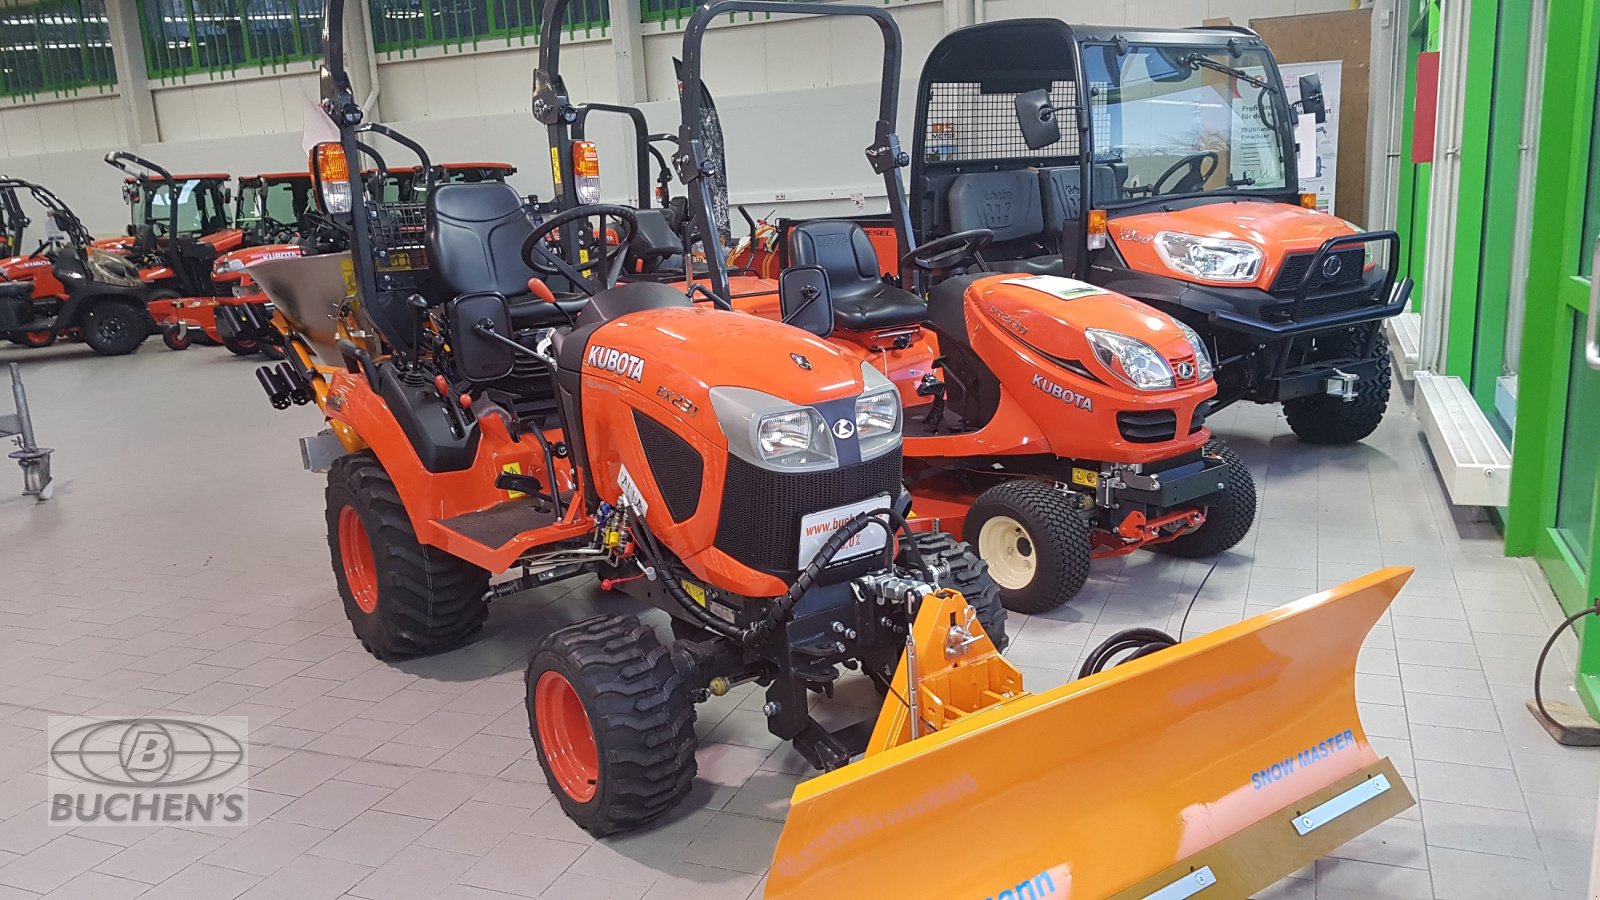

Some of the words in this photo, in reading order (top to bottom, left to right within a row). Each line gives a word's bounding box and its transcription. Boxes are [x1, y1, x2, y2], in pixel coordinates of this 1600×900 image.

[864, 229, 892, 237] IESEL
[262, 251, 297, 261] KUBOTA
[588, 345, 645, 383] KUBOTA
[656, 385, 700, 417] BX231
[1032, 373, 1094, 412] KUBOTA
[1251, 756, 1294, 790] SNOW
[1297, 729, 1355, 768] MASTER
